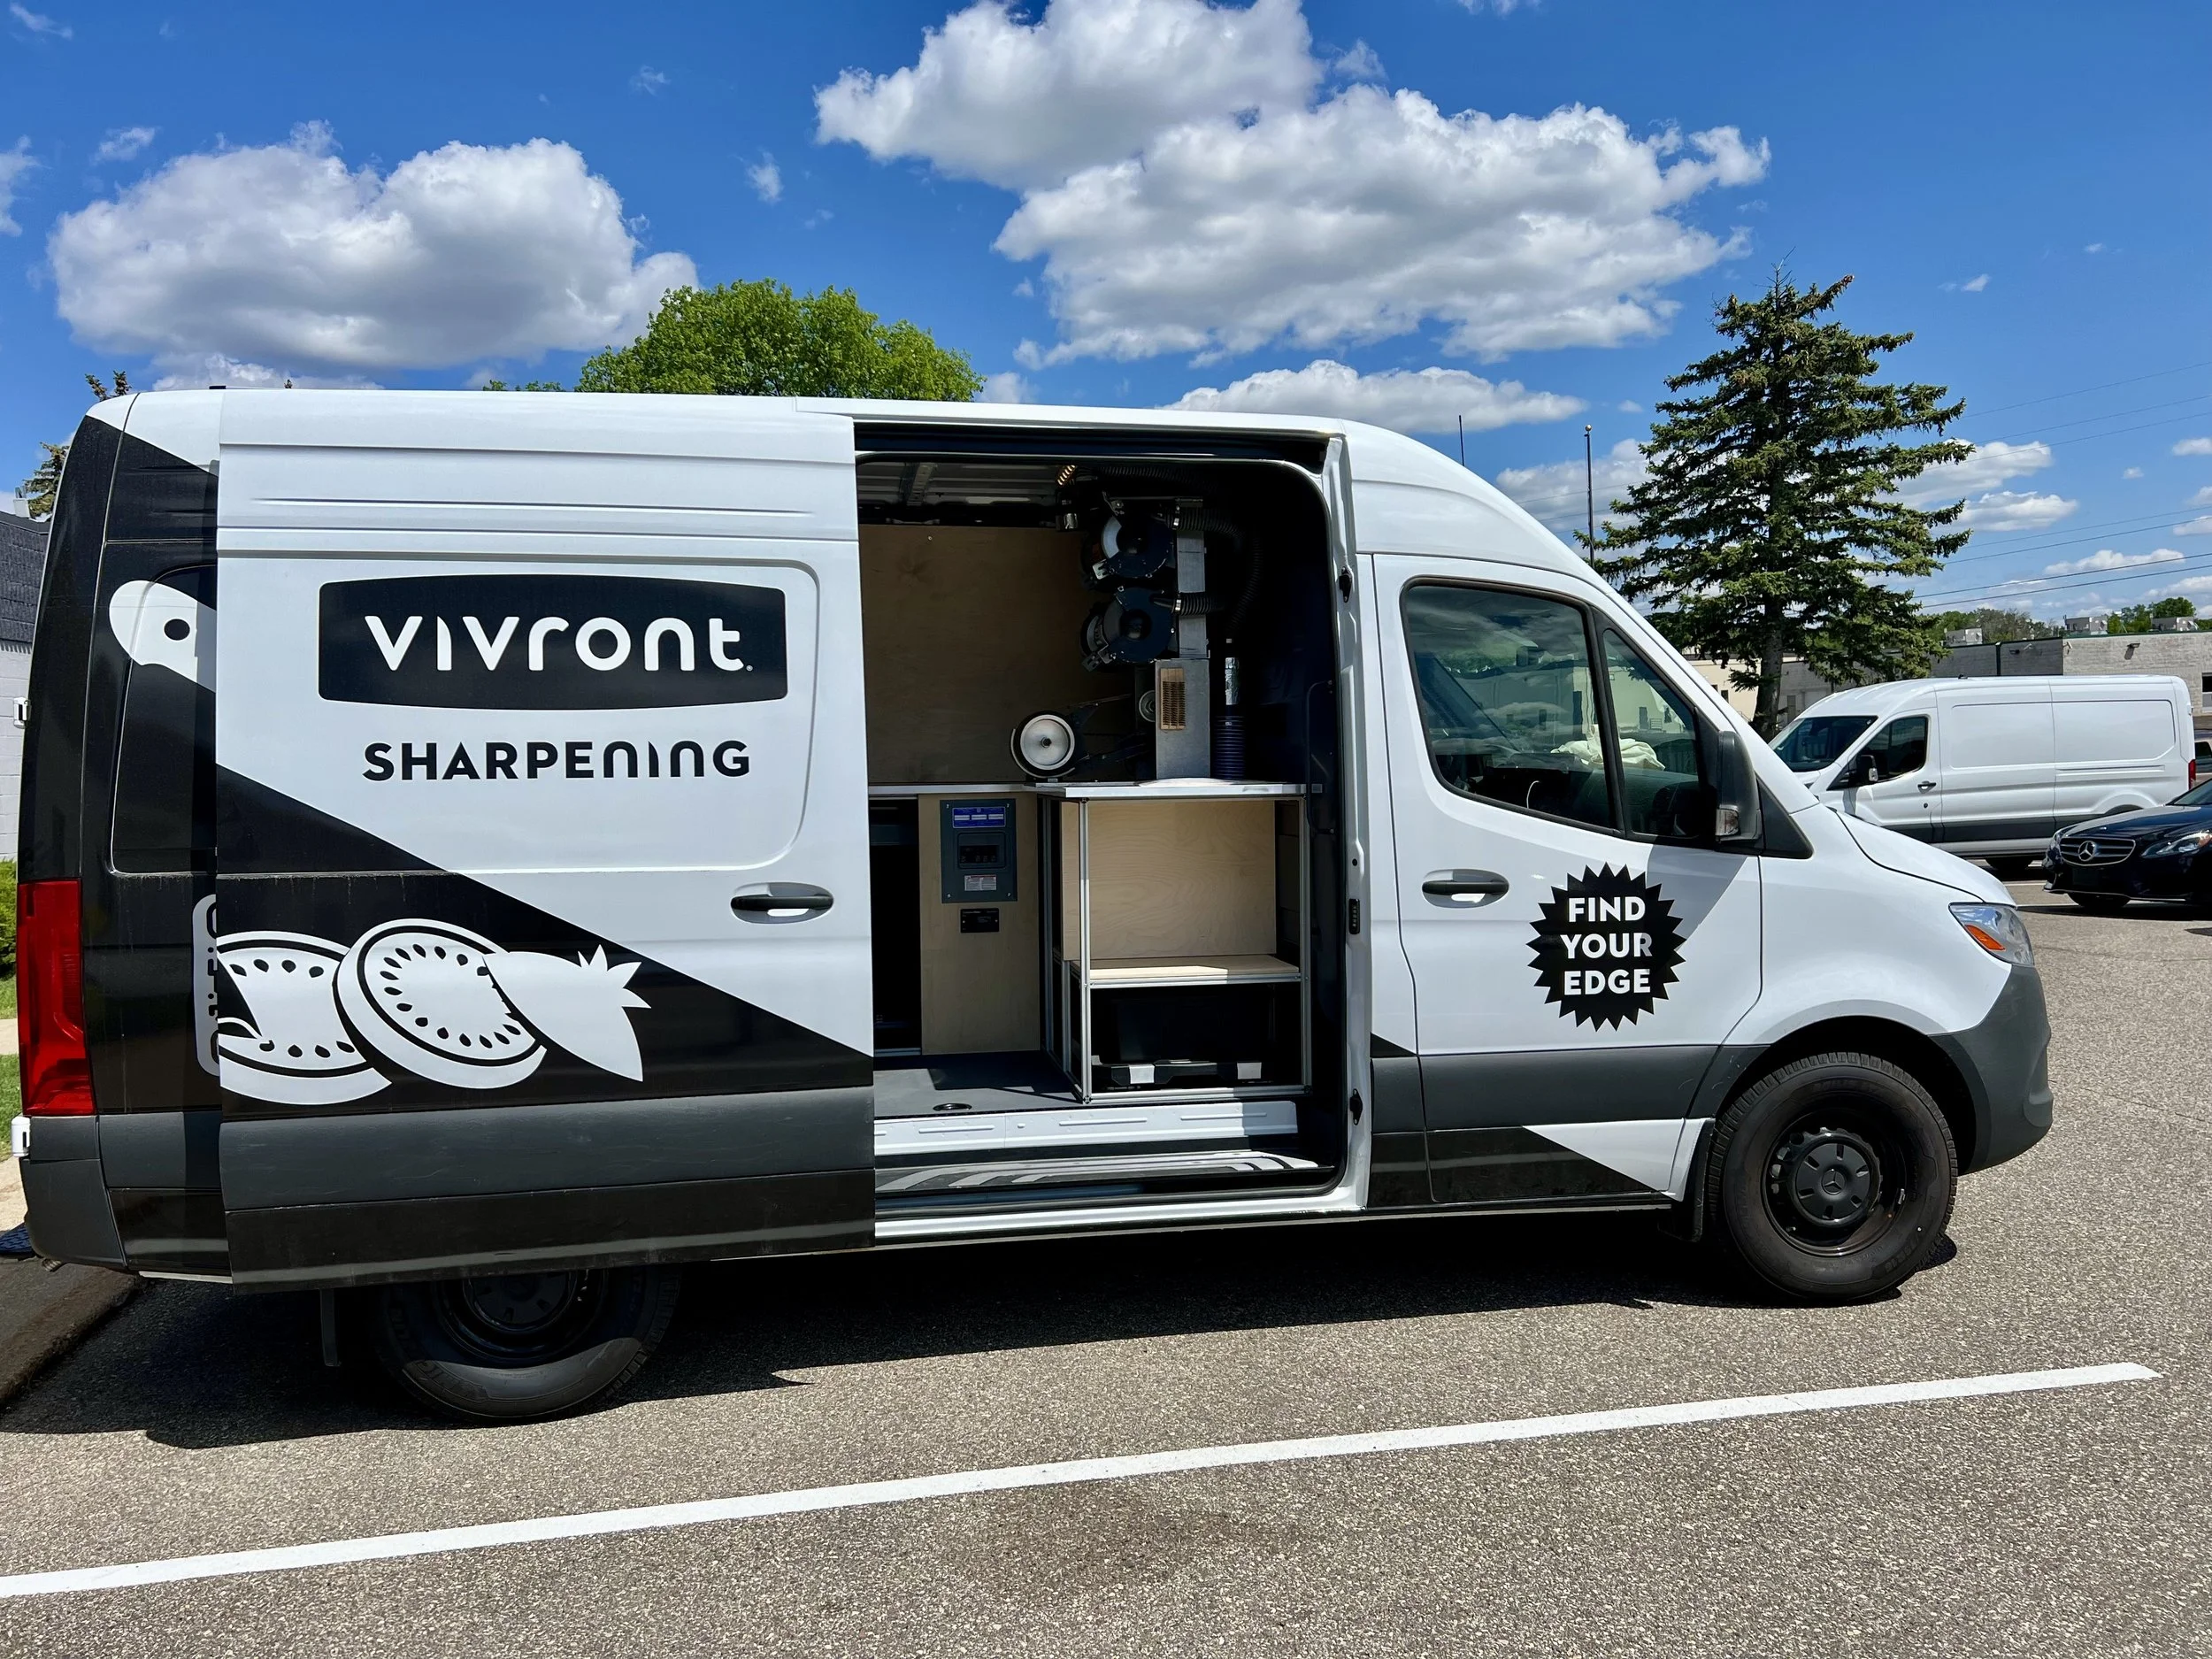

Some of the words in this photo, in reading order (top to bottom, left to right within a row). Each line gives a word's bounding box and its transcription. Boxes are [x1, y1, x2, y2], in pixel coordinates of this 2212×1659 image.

[1568, 895, 1646, 923] FIND
[1559, 932, 1653, 959] YOUR
[1563, 968, 1651, 995] EDGE
